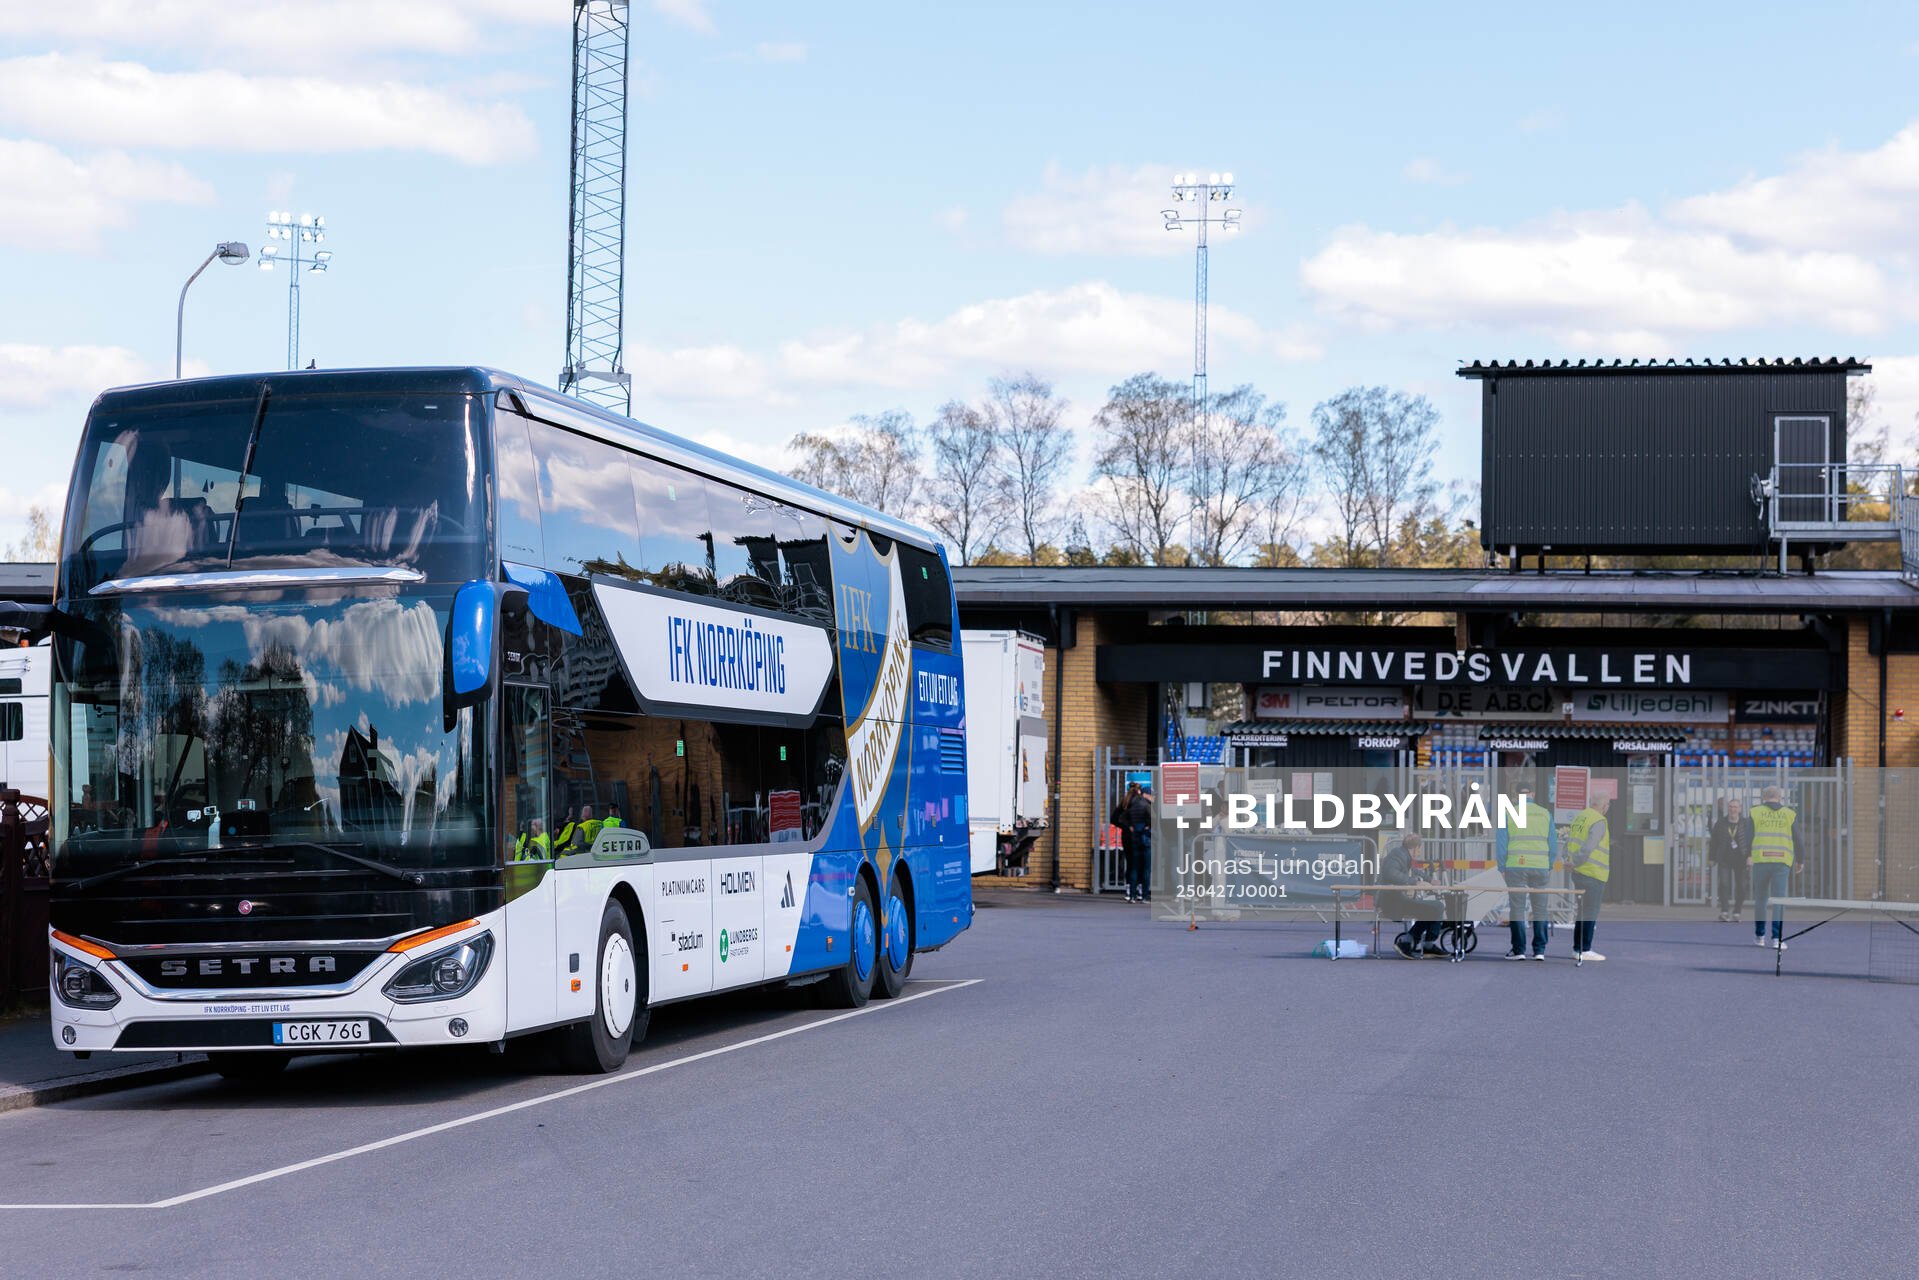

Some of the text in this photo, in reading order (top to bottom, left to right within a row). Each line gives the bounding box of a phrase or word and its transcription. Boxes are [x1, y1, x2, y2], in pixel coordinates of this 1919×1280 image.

[840, 583, 878, 655] IFK
[668, 615, 786, 695] IFK NORRKÖPING
[1262, 650, 1691, 684] FINNVEDSVALLEN
[918, 670, 928, 702] ETT
[938, 674, 948, 705] ETT
[856, 610, 909, 807] NORRKÖPING
[1261, 692, 1399, 709] 3M PELTOR
[1358, 735, 1401, 748] FÖRKÖP
[1490, 738, 1549, 749] FÖRSÄLJNING
[1613, 739, 1673, 751] FÖRSÄLJNING
[602, 840, 641, 852] SETRA
[662, 878, 705, 897] PLATINUMCARS
[720, 871, 756, 895] HOLMEN
[678, 931, 704, 952] stadium
[729, 928, 758, 945] LUNDBERGS
[161, 956, 336, 976] SETRA
[203, 1005, 213, 1013] IFK
[213, 1005, 247, 1013] NORRKÖPING
[251, 1005, 260, 1013] ETT
[280, 1004, 290, 1012] LAG
[289, 1023, 362, 1041] CGK 76G
